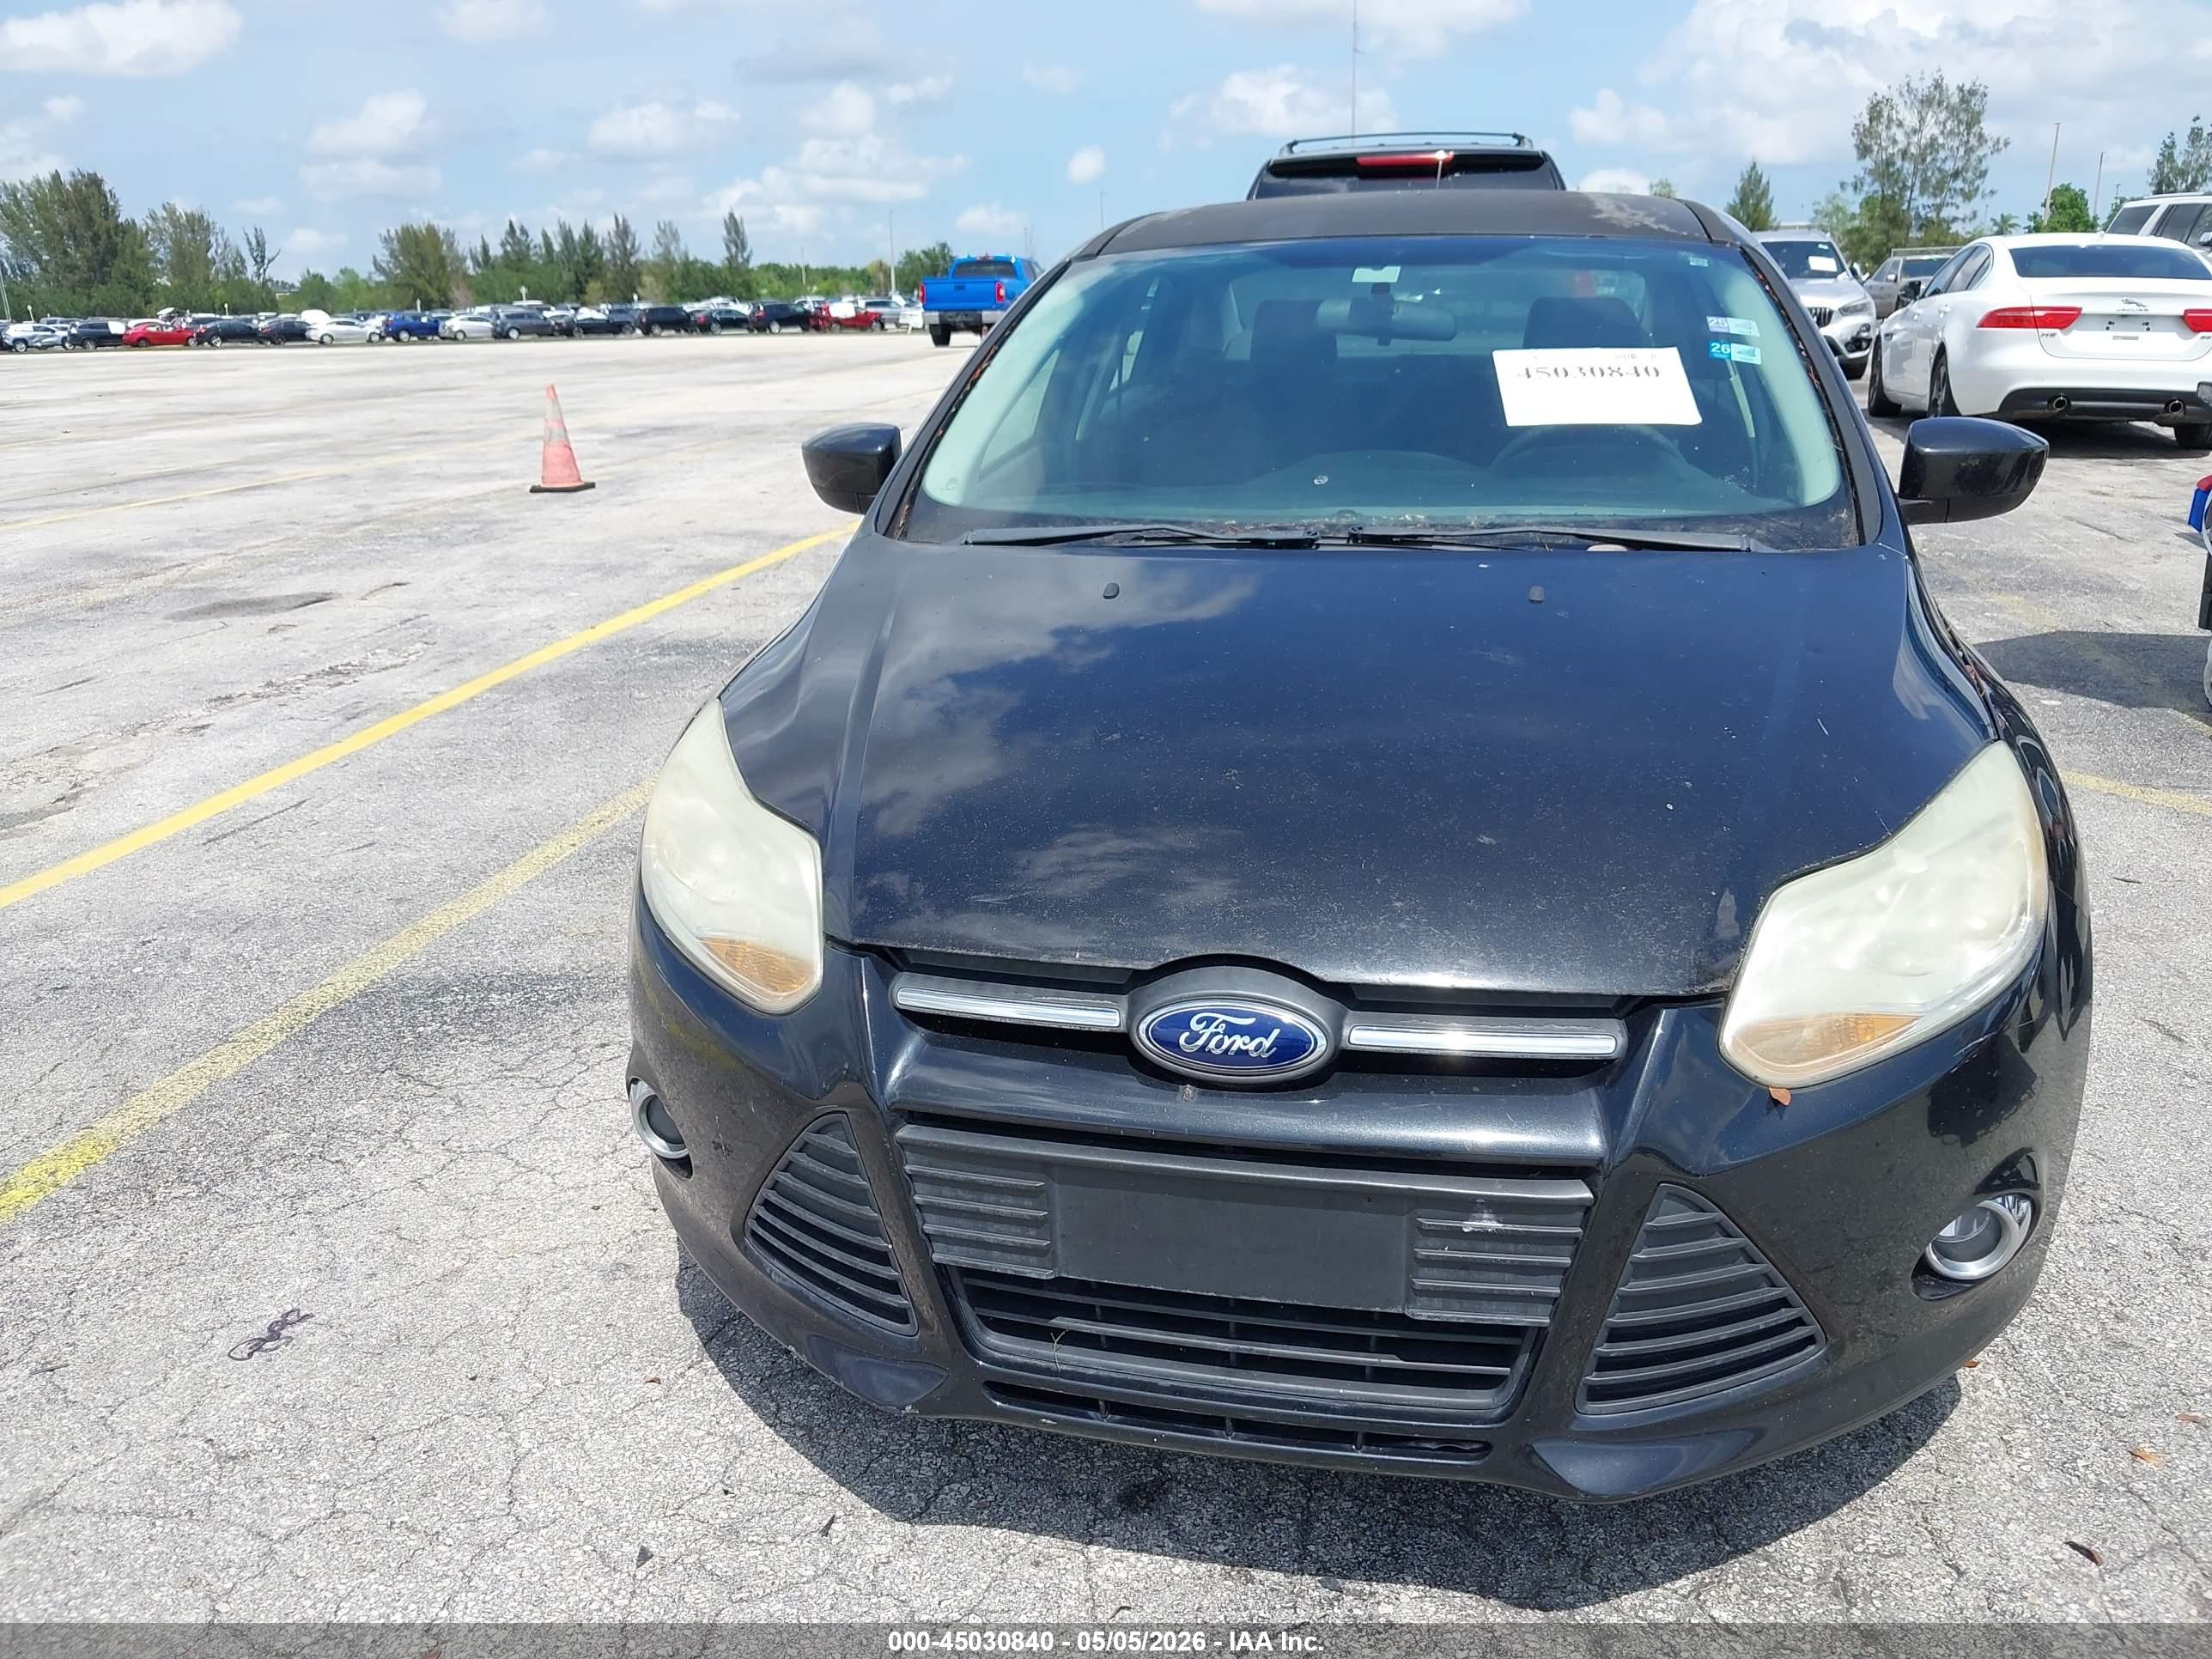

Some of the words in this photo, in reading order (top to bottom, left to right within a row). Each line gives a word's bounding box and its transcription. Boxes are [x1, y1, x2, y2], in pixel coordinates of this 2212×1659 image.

[1711, 342, 1730, 355] 26
[1518, 365, 1661, 379] 45030840
[1179, 1012, 1281, 1058] Ford
